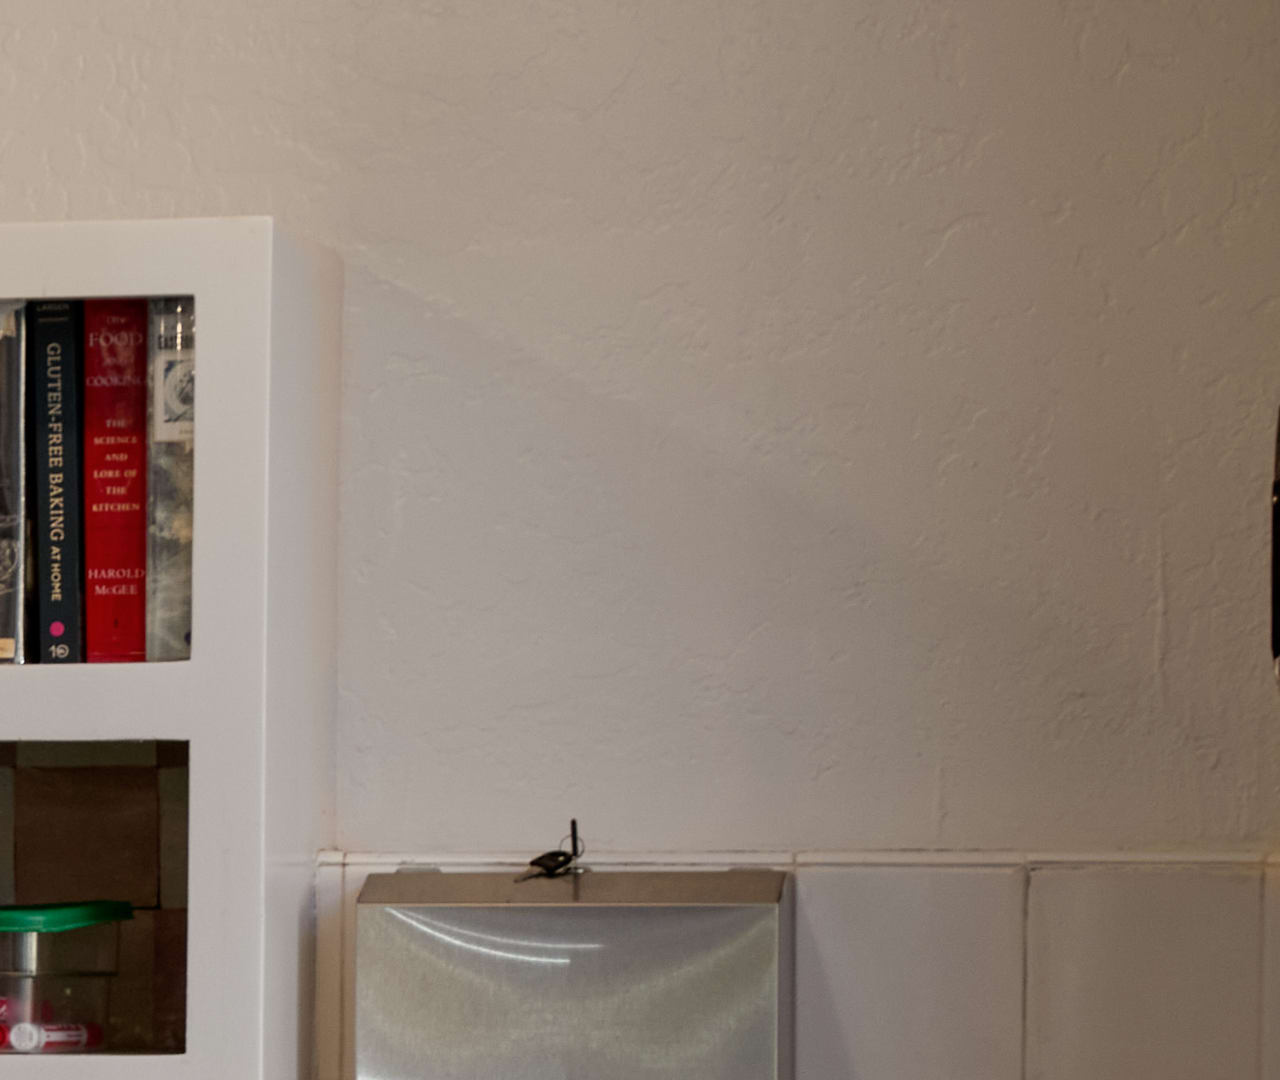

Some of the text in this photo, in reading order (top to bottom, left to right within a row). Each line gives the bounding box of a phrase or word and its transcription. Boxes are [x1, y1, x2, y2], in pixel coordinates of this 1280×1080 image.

[88, 331, 144, 348] FOOD
[105, 418, 128, 429] THE
[92, 436, 138, 445] SCIENCE
[104, 452, 128, 462] AND
[45, 342, 65, 602] GLUTEN-FREE BAKING AT HOME
[93, 468, 138, 479] LORE OF
[105, 485, 128, 495] THE
[91, 502, 140, 512] KITCHEN
[87, 567, 146, 580] HAROLD
[94, 584, 138, 596] McGEE
